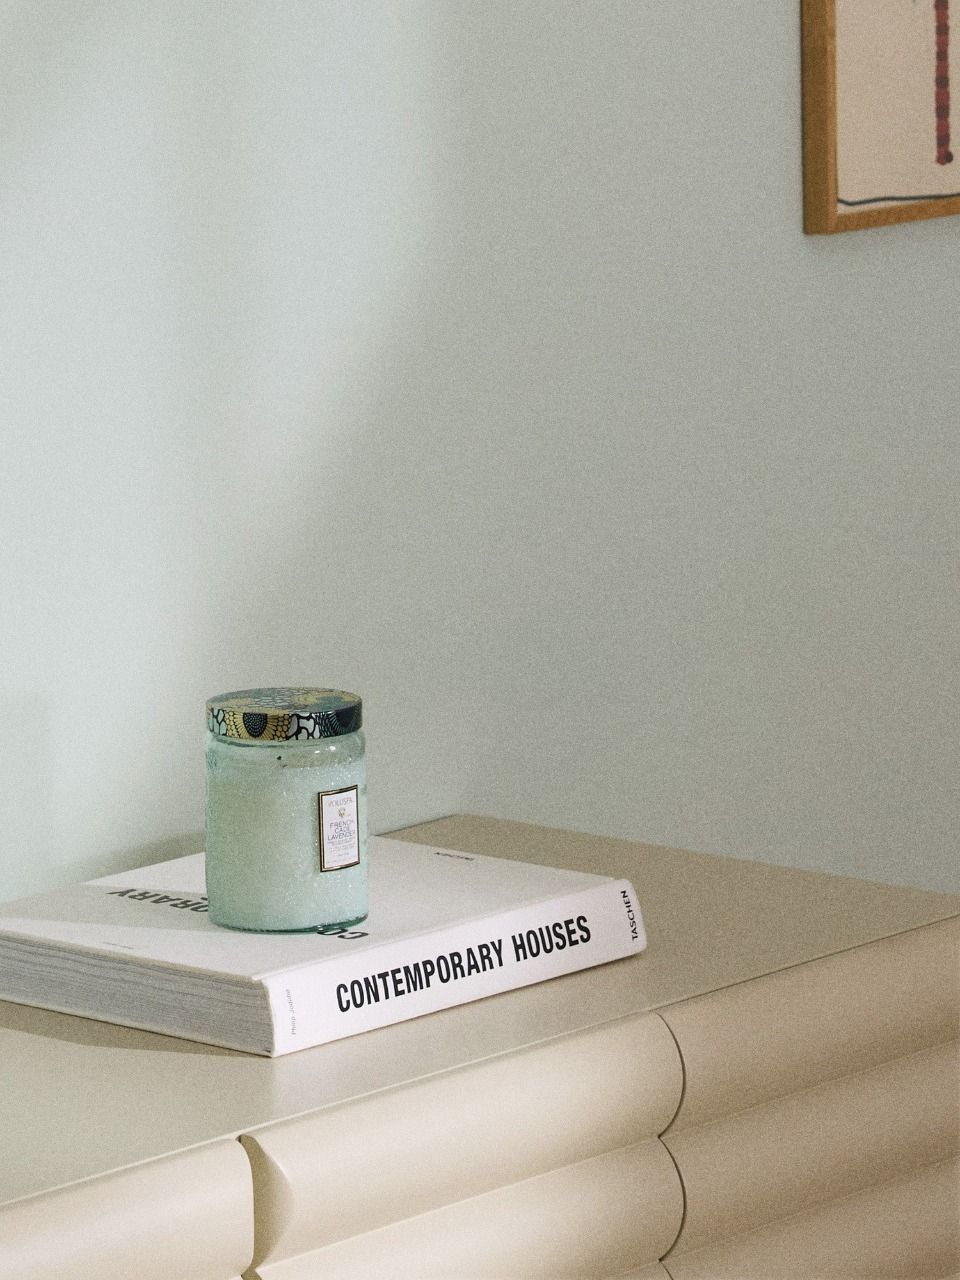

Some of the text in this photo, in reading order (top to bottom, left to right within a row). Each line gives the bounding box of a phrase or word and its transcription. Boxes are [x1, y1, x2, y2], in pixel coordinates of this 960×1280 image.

[620, 890, 638, 941] TASCHEN
[336, 915, 591, 1013] CONTEMPORARY HOUSES
